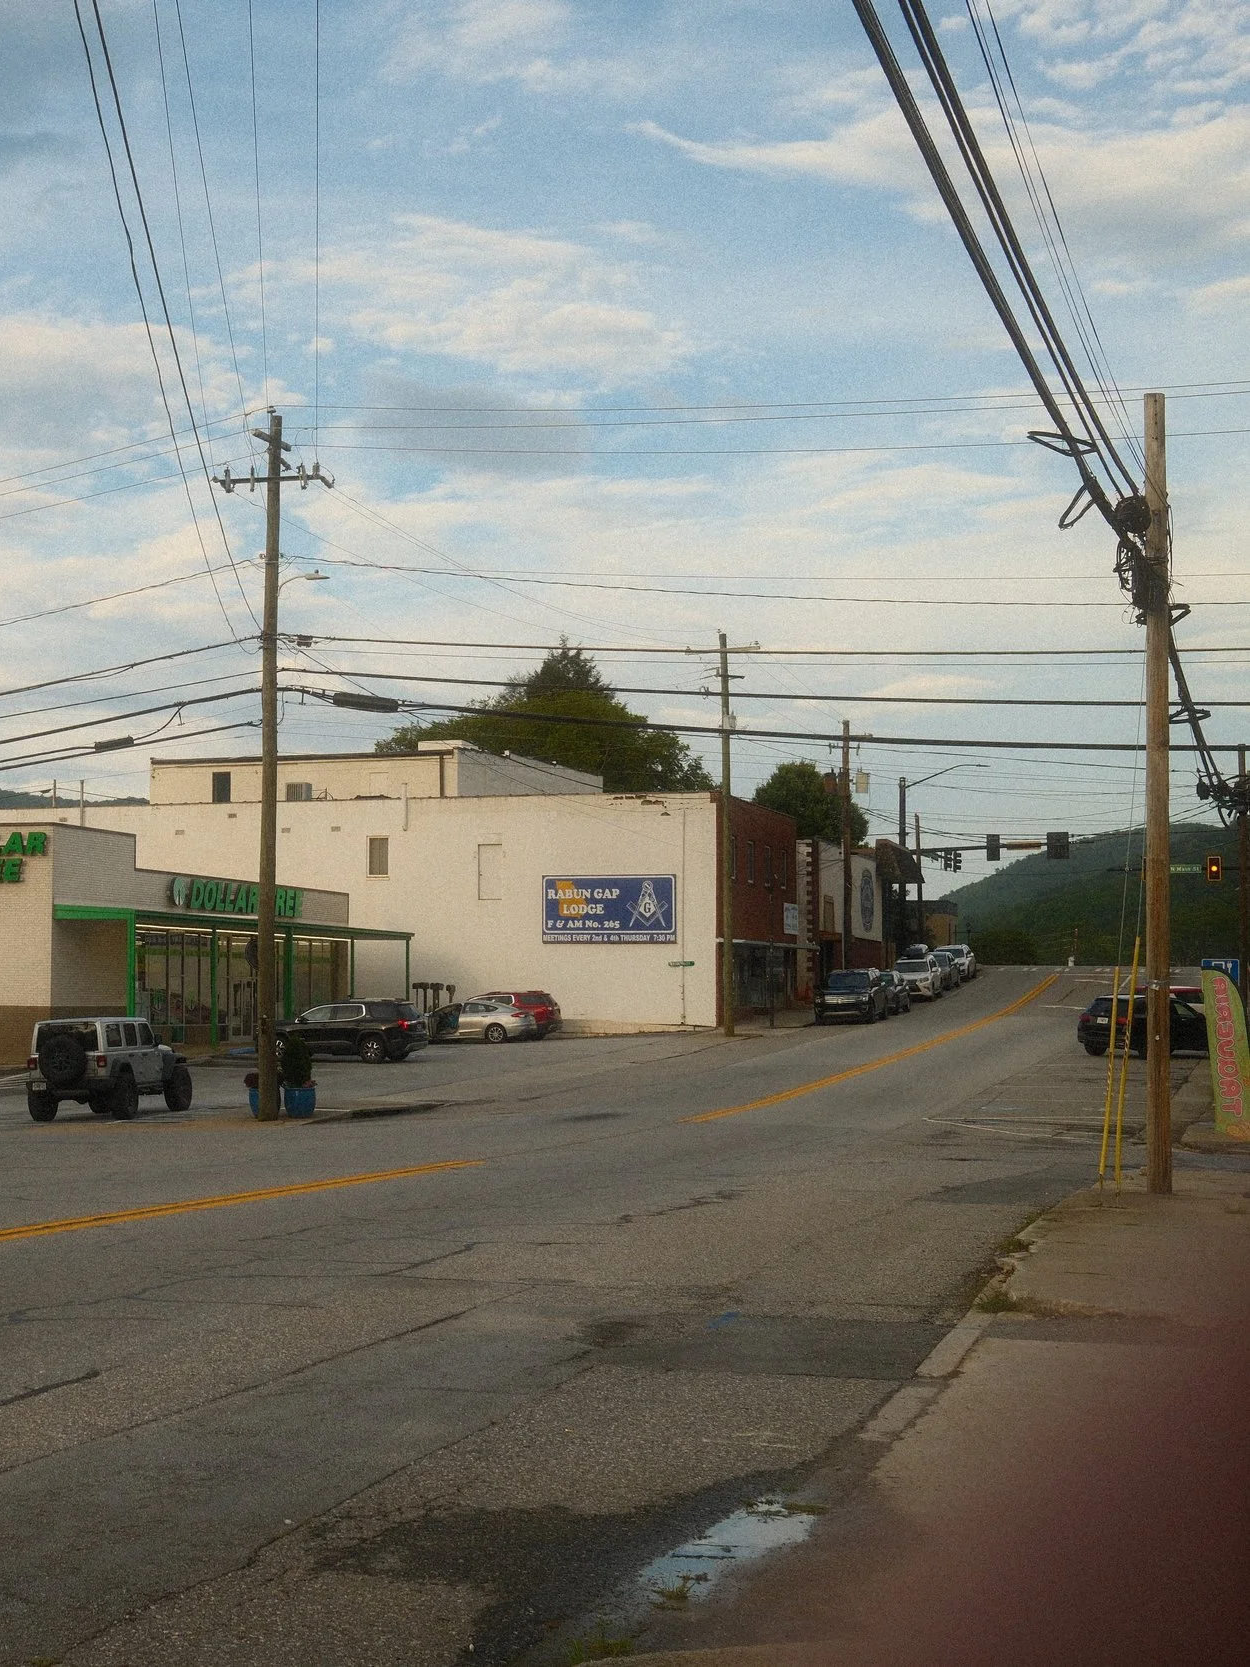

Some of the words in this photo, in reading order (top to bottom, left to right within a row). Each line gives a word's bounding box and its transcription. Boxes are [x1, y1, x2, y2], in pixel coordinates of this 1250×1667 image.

[190, 879, 260, 914] DOLLAR
[275, 887, 304, 917] REE
[547, 888, 591, 900] RABUN
[593, 888, 620, 900] GAP
[563, 904, 604, 915] LODGE
[547, 920, 554, 928] F
[556, 920, 565, 928] &
[567, 920, 584, 928] AM
[585, 920, 601, 928] No.
[603, 920, 620, 929] 265
[543, 934, 572, 942] MEETINGS
[572, 934, 591, 942] EVERY
[591, 934, 602, 942] 2nd
[610, 934, 619, 942] 4th
[620, 934, 650, 942] THURSDAY
[653, 934, 665, 942] 7:30
[666, 934, 675, 942] PM
